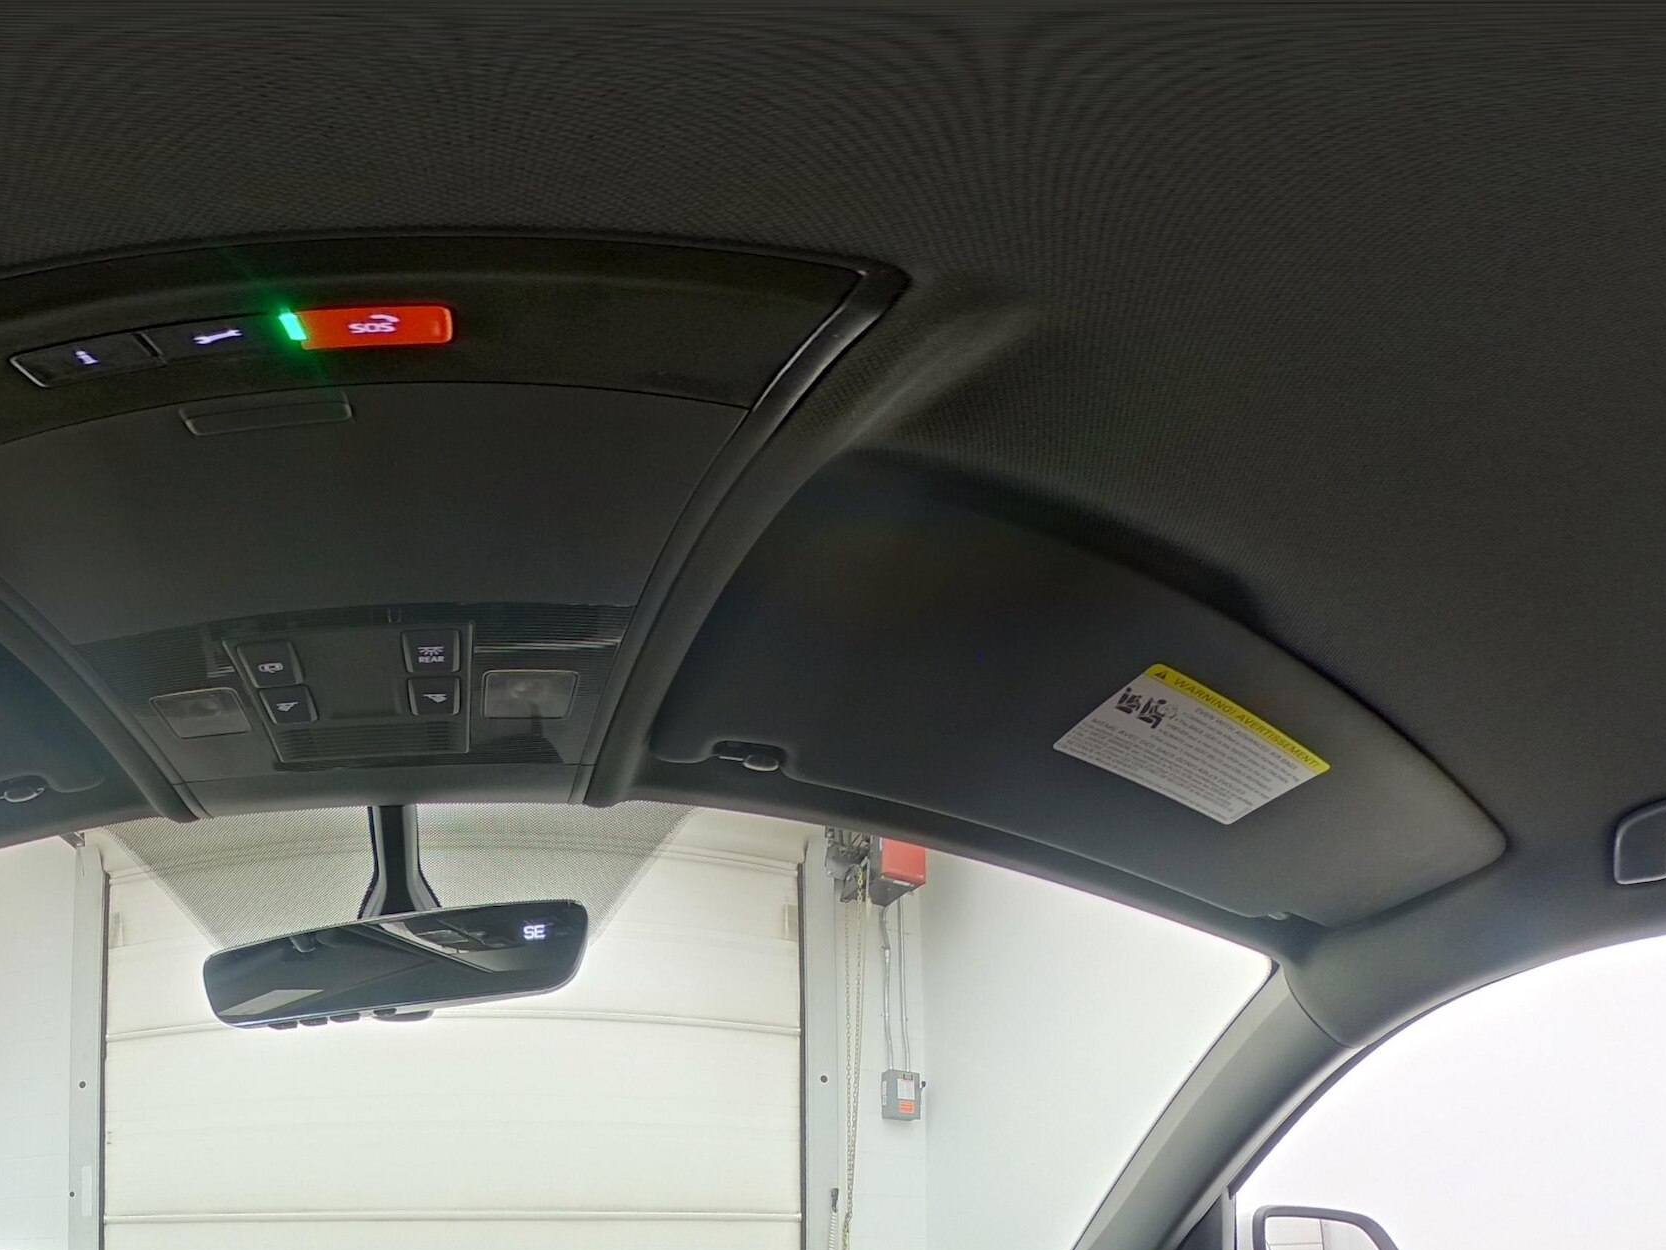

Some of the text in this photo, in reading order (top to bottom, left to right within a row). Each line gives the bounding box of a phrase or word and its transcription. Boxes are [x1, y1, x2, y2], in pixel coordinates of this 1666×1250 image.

[348, 322, 395, 333] SOS
[1171, 676, 1237, 715] WARNING!
[1234, 712, 1319, 766] AVERTISSEMENT!
[523, 925, 546, 940] SE
